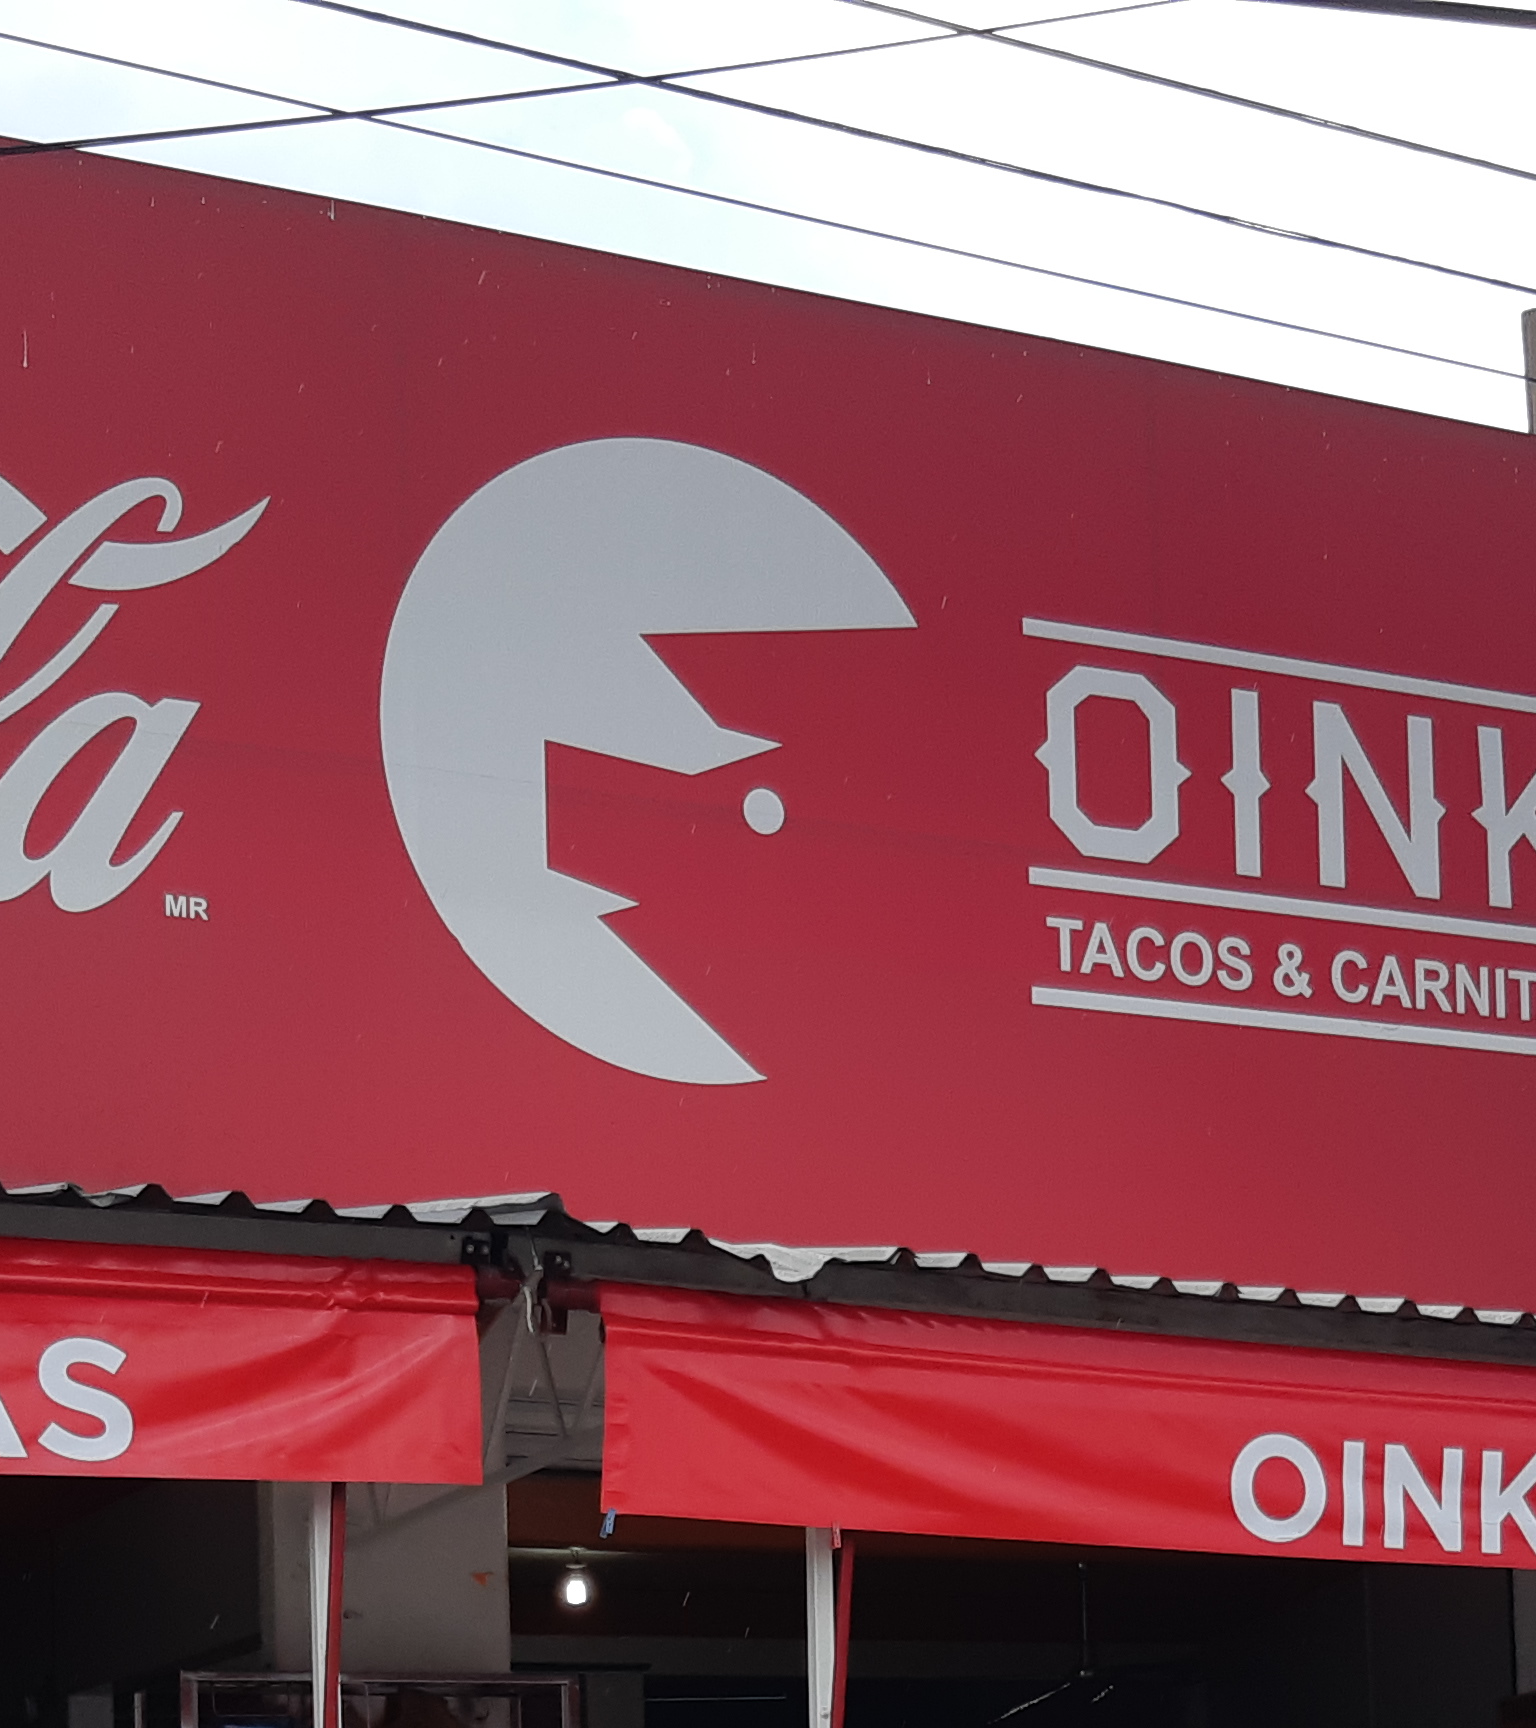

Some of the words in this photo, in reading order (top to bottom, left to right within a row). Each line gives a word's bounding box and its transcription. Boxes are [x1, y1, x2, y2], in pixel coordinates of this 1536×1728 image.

[165, 893, 209, 921] MR
[1045, 915, 1254, 991] TACOS
[1272, 942, 1313, 999] &
